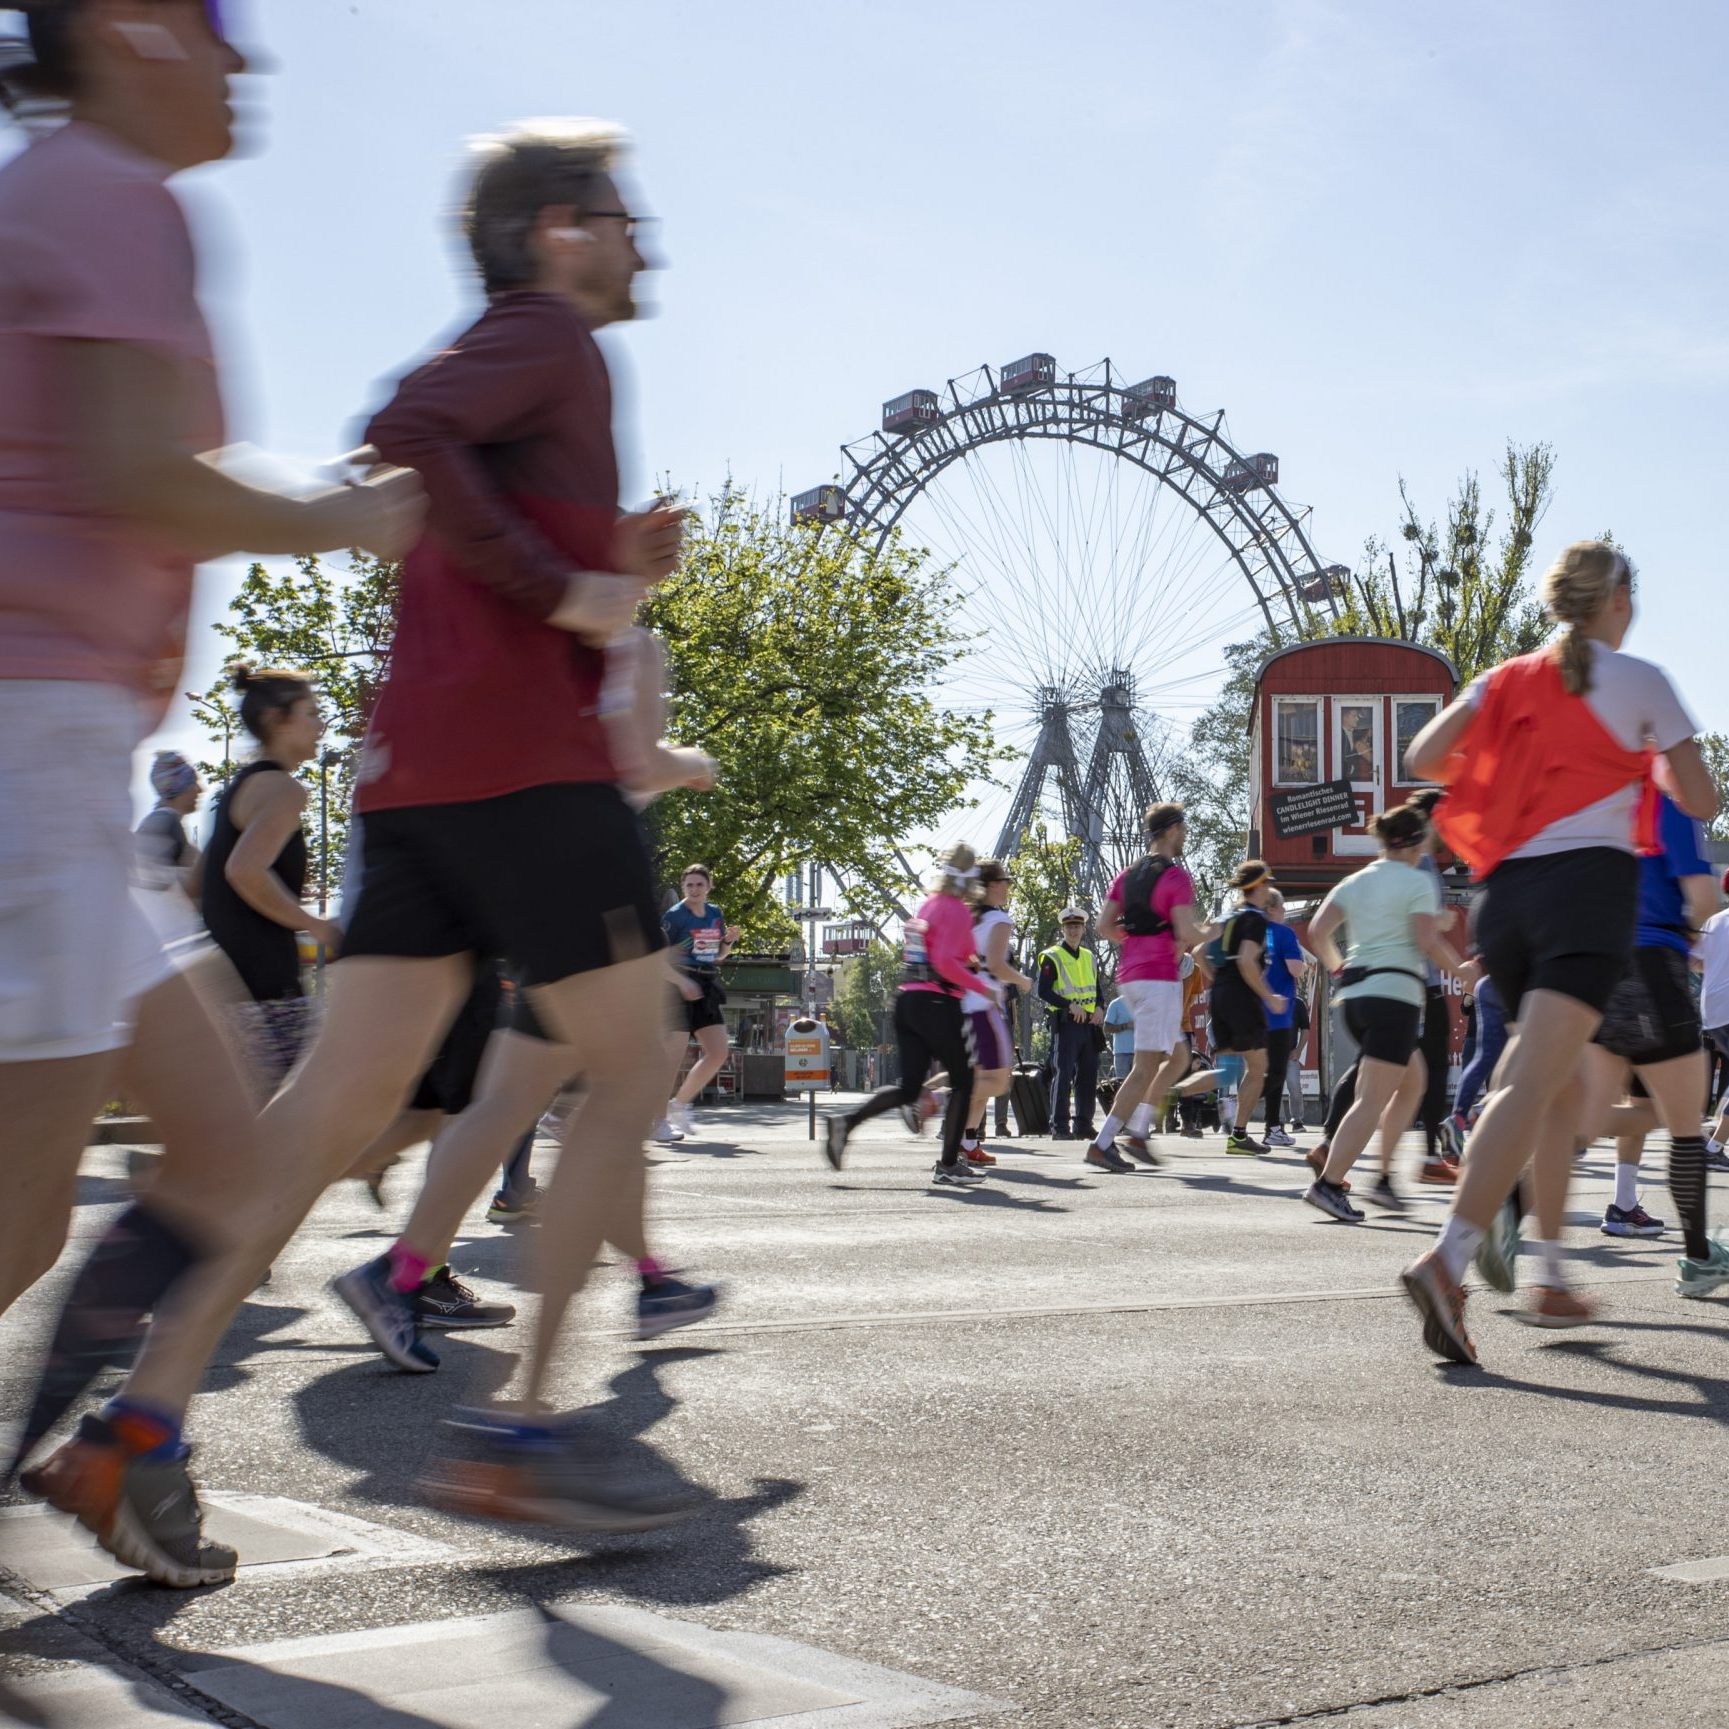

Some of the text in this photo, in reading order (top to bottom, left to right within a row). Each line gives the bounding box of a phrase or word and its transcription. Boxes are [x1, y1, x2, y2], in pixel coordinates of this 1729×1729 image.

[1276, 792, 1349, 815] CANDLELIGHT DINNER
[1287, 787, 1334, 803] Romantisches
[1290, 810, 1315, 821] Wiener
[1315, 801, 1349, 815] Riesenrad
[1282, 813, 1352, 834] wienerriesenrad.com
